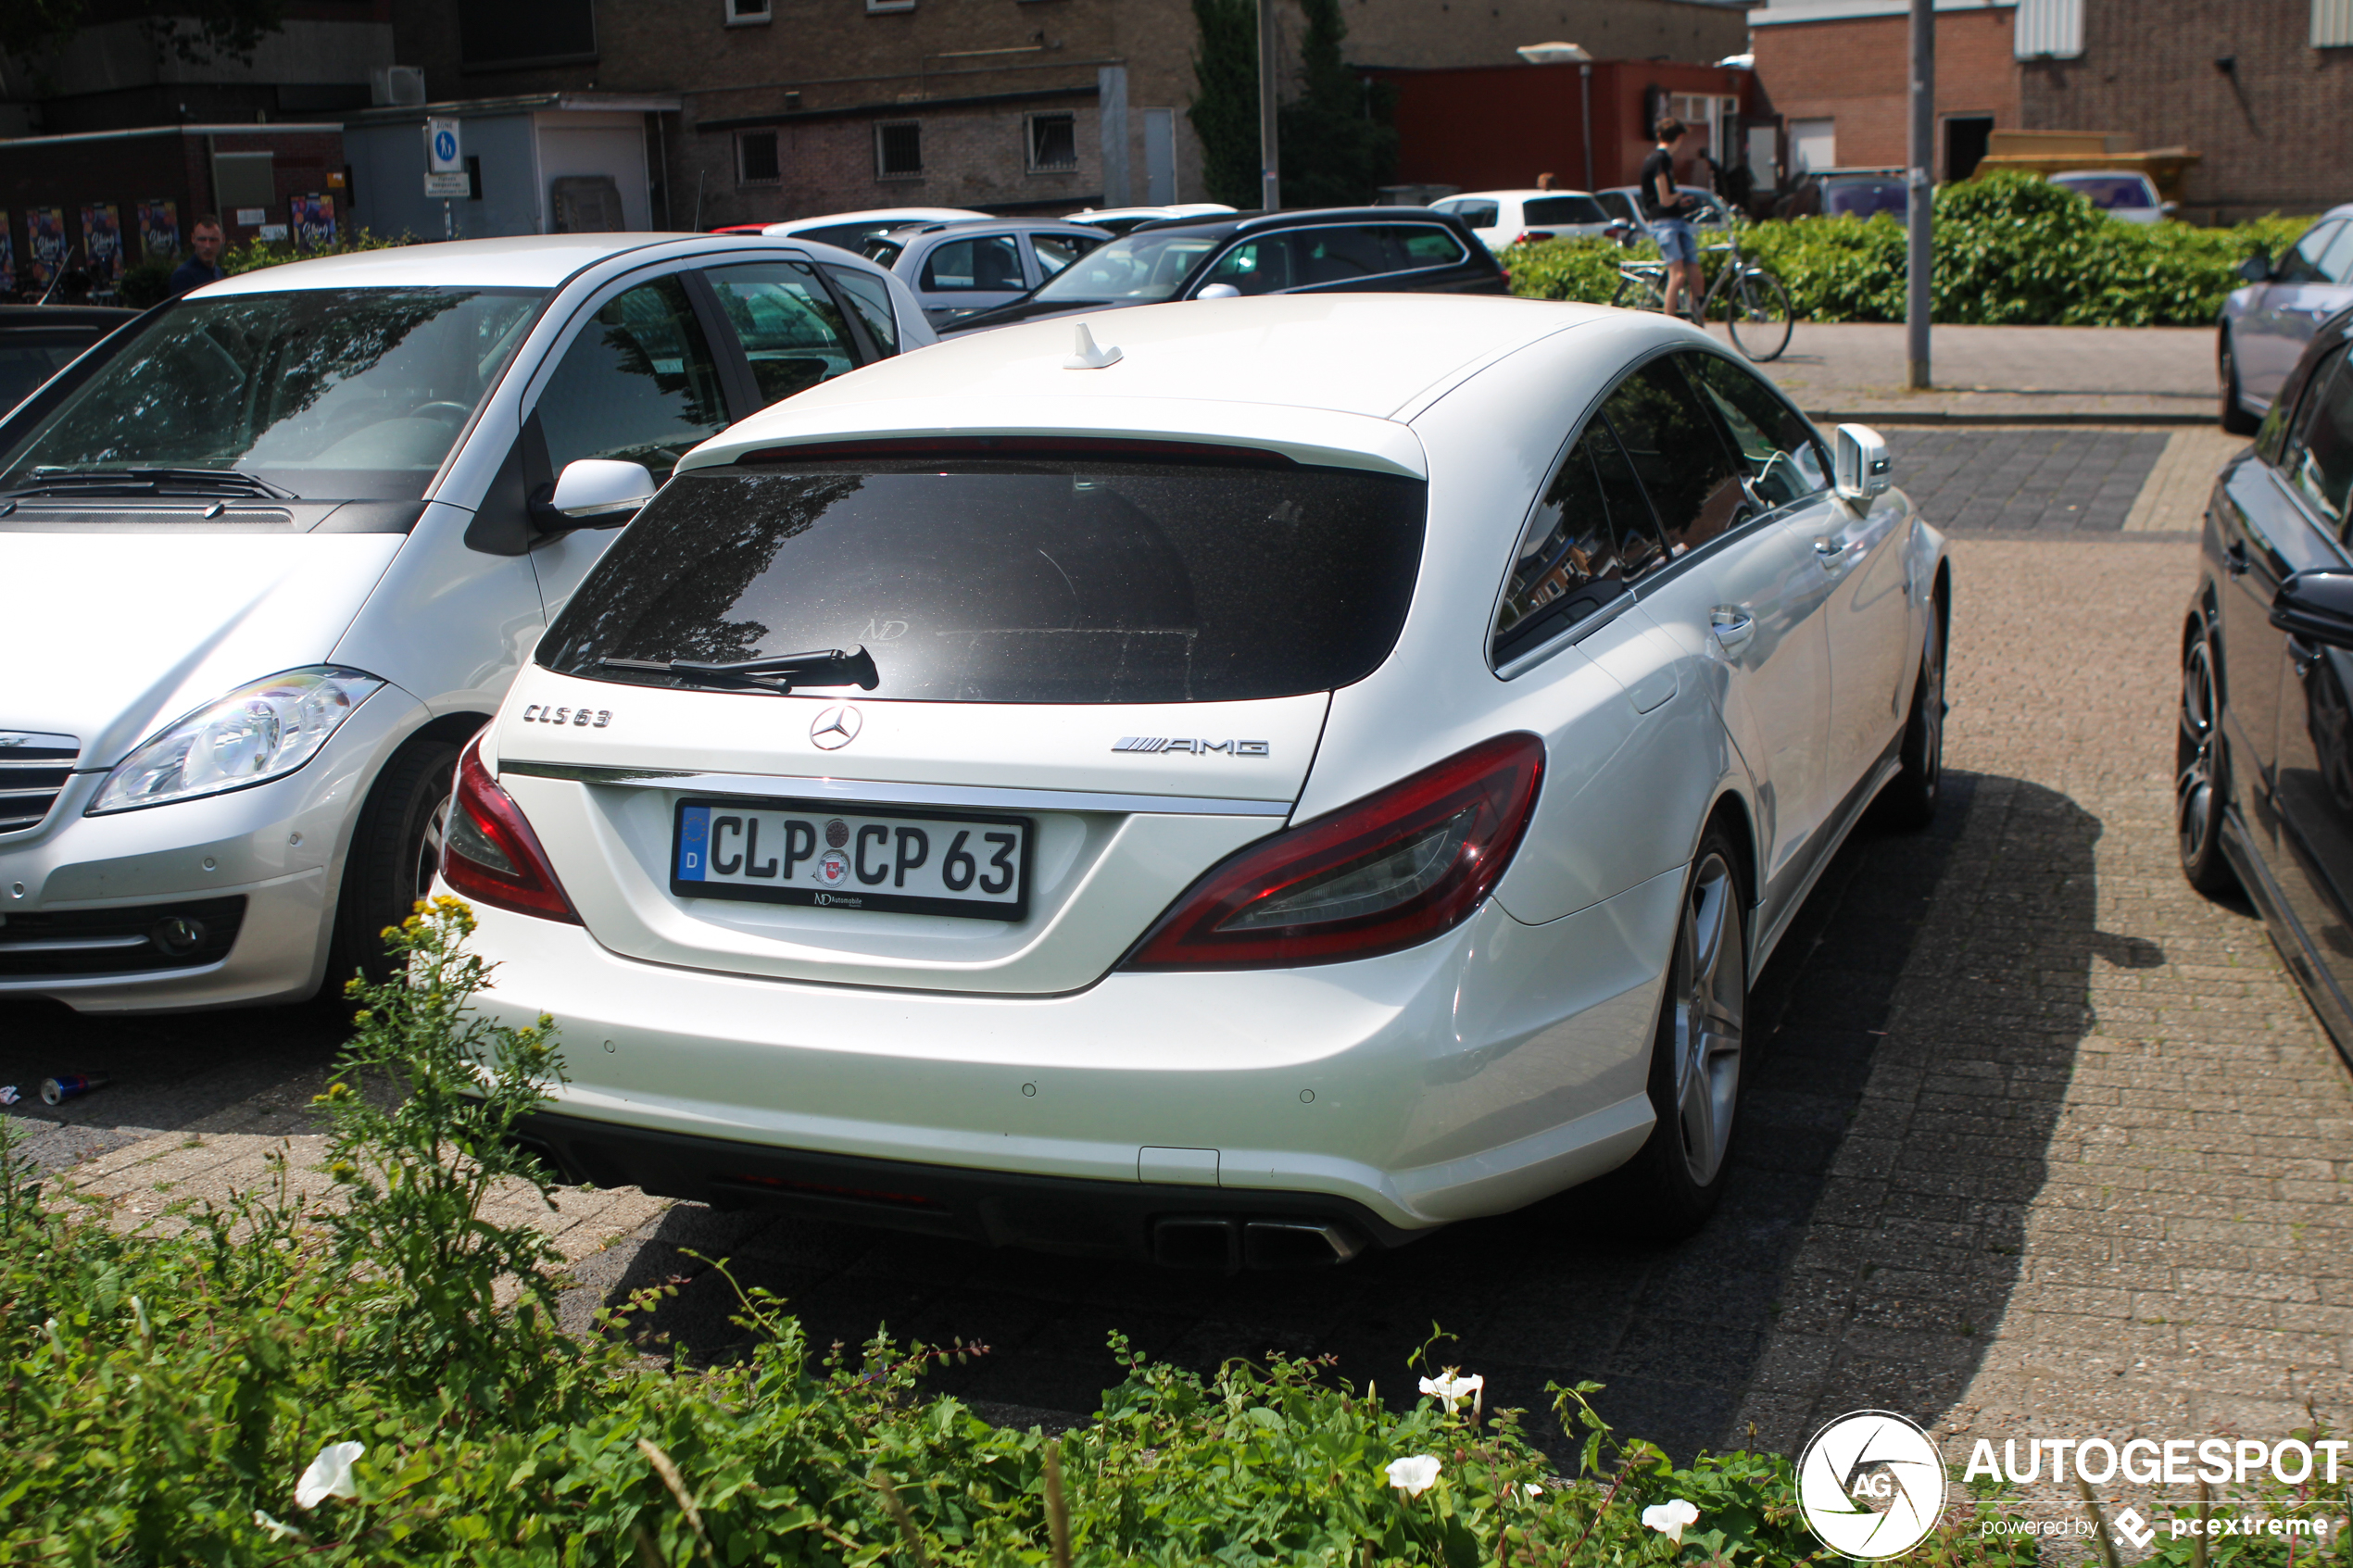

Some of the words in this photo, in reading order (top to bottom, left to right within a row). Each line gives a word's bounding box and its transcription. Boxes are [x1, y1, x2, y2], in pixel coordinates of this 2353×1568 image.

[523, 705, 571, 724] CLS
[573, 709, 613, 728] 63
[1160, 738, 1270, 757] AMG
[686, 852, 698, 869] D
[711, 816, 816, 879] CLP
[856, 824, 929, 886] CP
[942, 831, 1015, 894] 63
